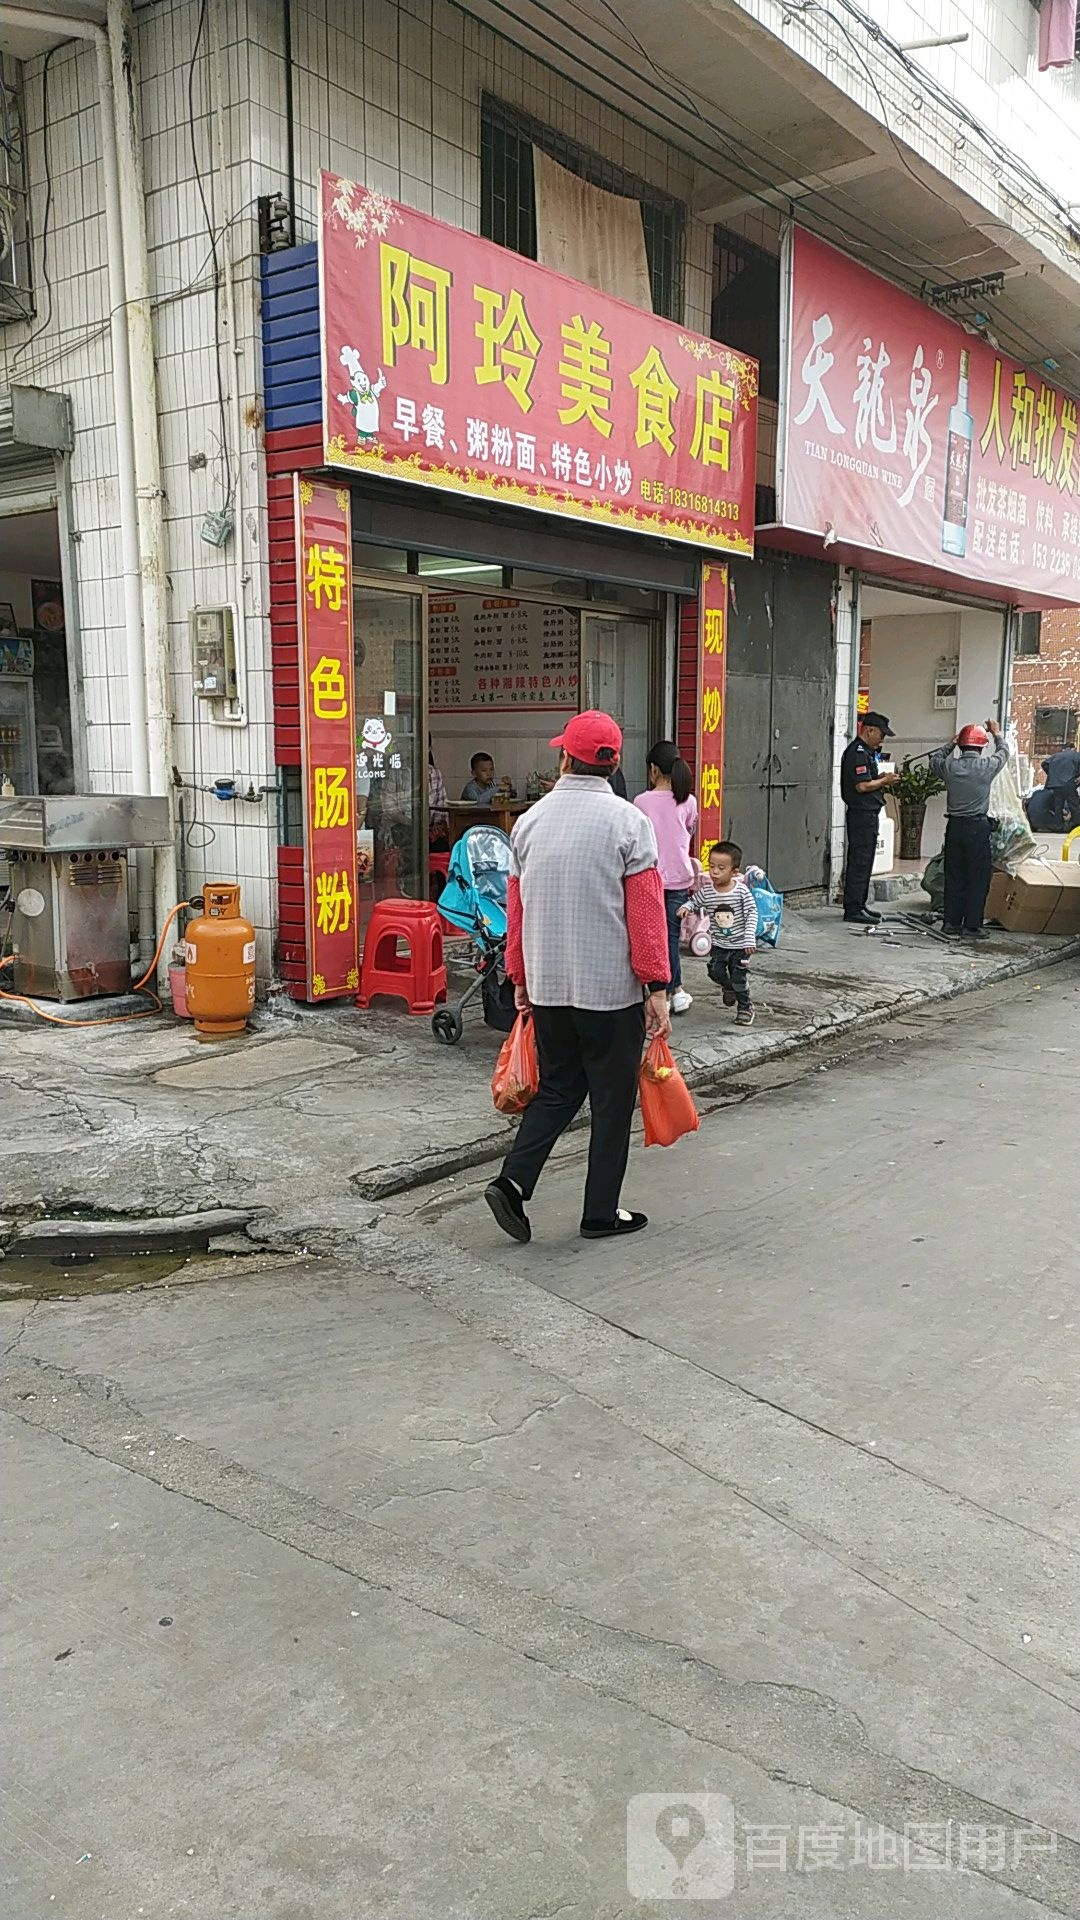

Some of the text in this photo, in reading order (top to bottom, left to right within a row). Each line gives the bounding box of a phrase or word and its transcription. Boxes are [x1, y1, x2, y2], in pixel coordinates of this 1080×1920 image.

[380, 242, 737, 472] 阿玲美食店
[393, 396, 633, 496] 早餐、粥粉面、特色小炒
[804, 440, 903, 488] TIAN LONGQUAN WINE
[979, 358, 1080, 497] 人和批发
[975, 475, 1080, 547] 批发茶烟酒、饮料、承接
[308, 543, 352, 935] 特色肠粉
